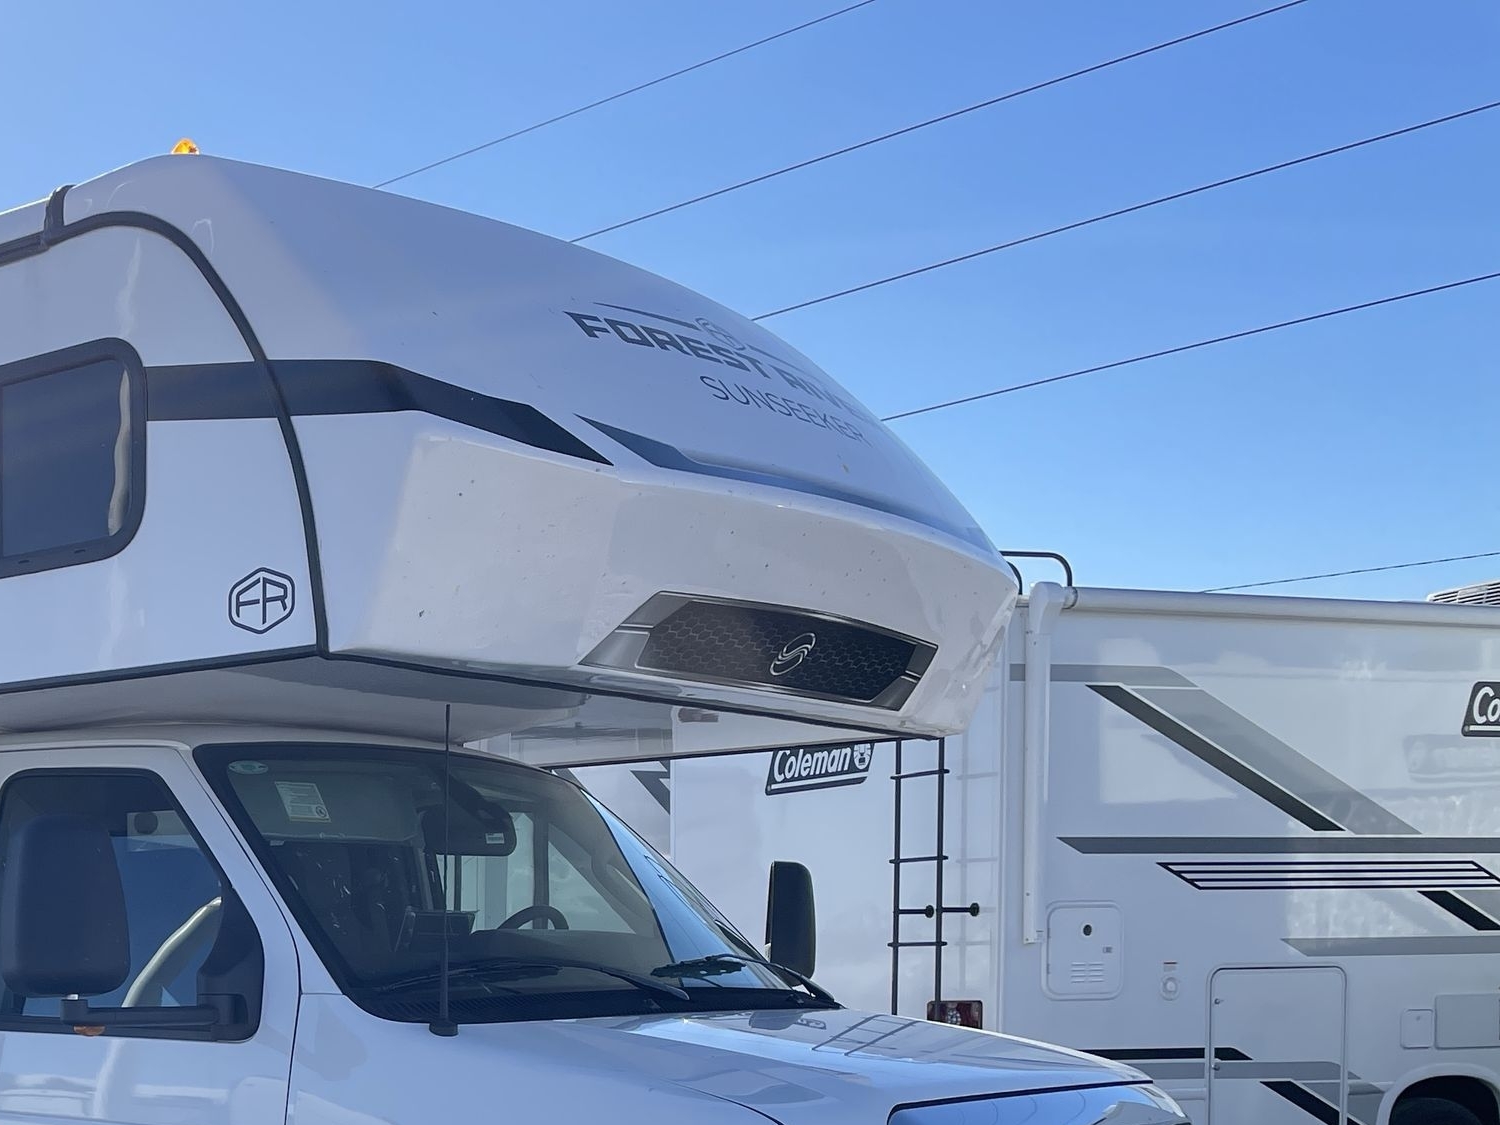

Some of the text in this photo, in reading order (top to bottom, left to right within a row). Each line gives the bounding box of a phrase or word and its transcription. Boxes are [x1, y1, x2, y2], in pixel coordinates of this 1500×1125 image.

[562, 310, 772, 379] FOREST
[699, 375, 873, 448] SUNSEEKER
[773, 747, 852, 783] Coleman
